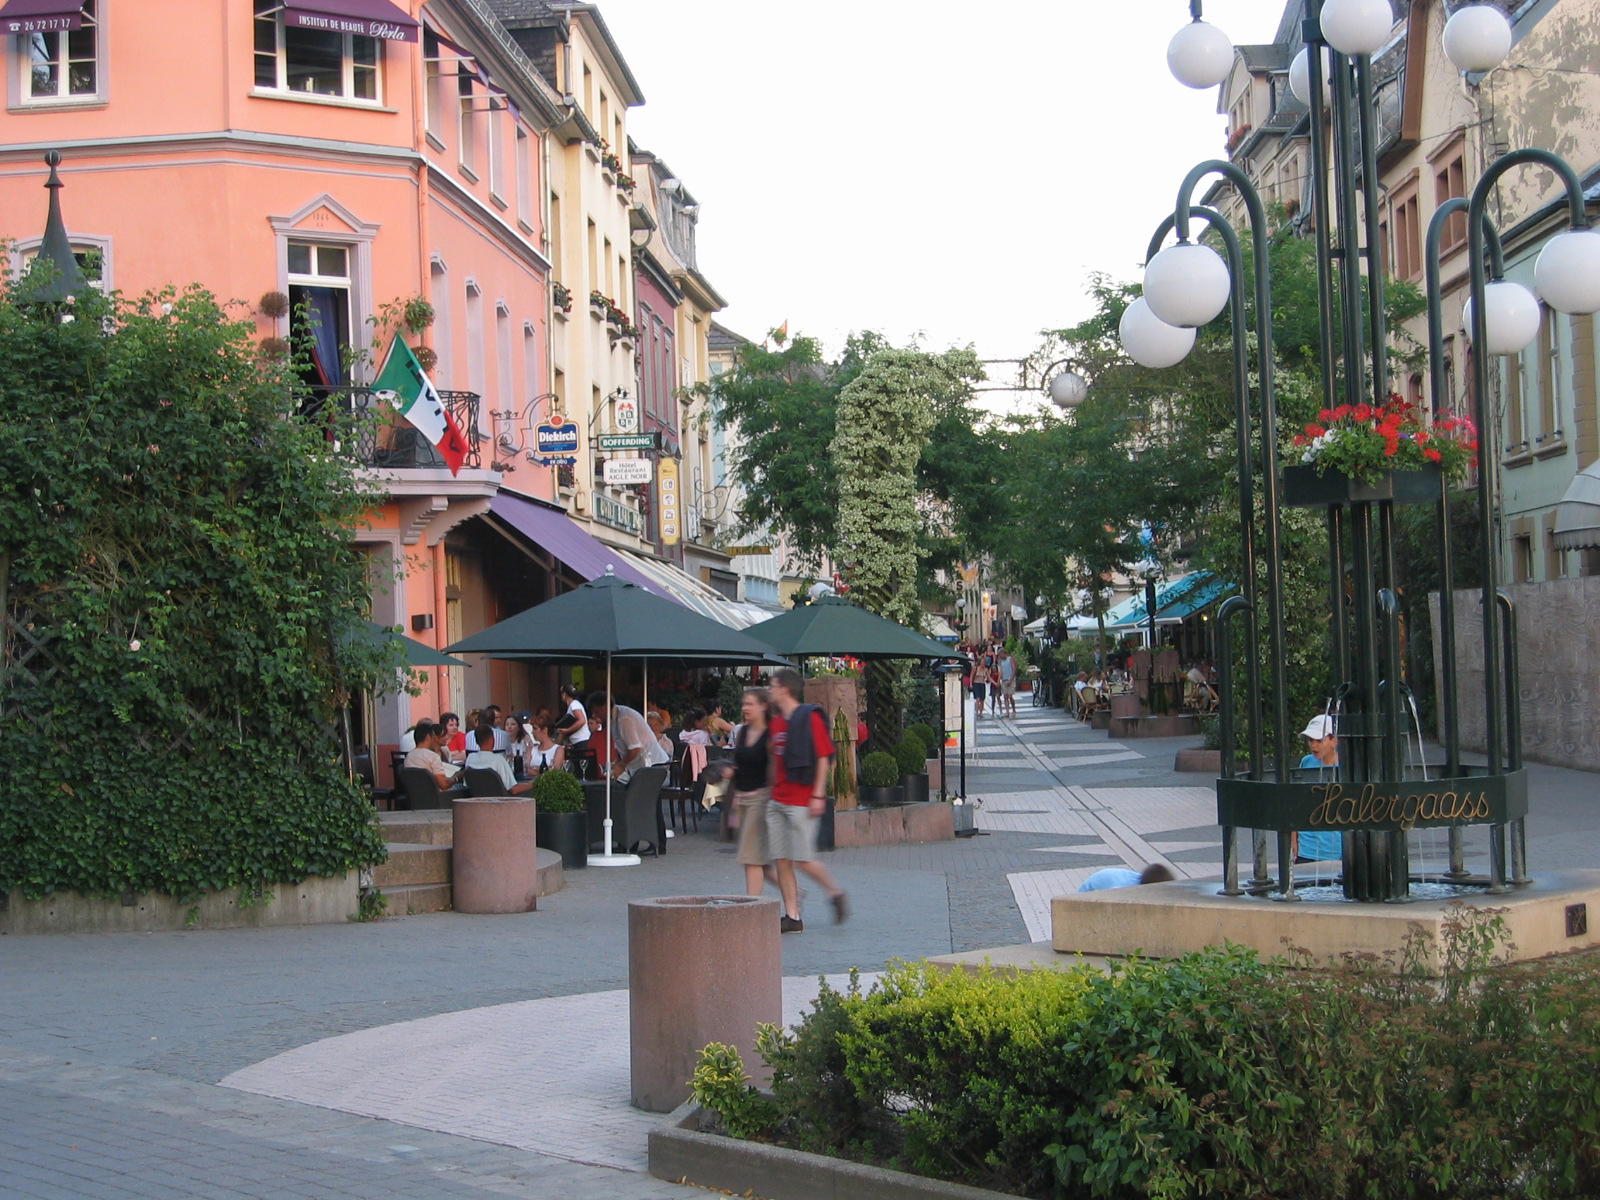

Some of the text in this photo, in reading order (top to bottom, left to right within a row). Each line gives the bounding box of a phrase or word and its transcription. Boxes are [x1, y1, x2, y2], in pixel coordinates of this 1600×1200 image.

[25, 18, 71, 31] 26 72 17 17
[298, 15, 328, 28] INSTITUT
[330, 19, 339, 30] DE
[538, 430, 576, 442] Diekirch
[602, 437, 650, 446] BOFFERDING
[1309, 783, 1490, 831] Halergaass
